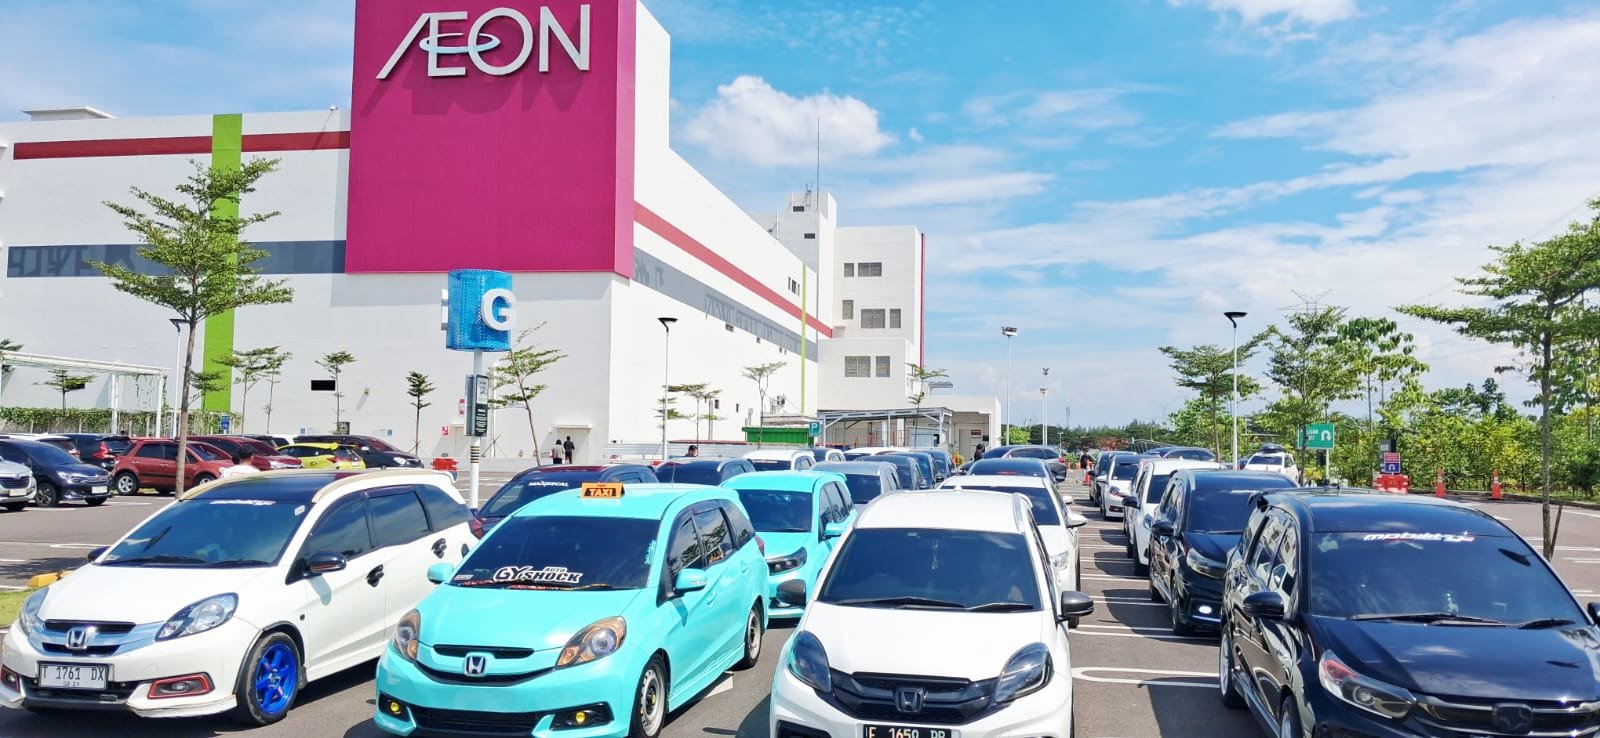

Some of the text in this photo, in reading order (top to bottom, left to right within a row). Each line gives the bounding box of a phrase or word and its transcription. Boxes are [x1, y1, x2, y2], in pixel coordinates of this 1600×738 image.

[482, 288, 517, 331] G
[811, 422, 818, 432] P
[588, 488, 614, 496] TAXI
[42, 666, 105, 682] T 1761 DX
